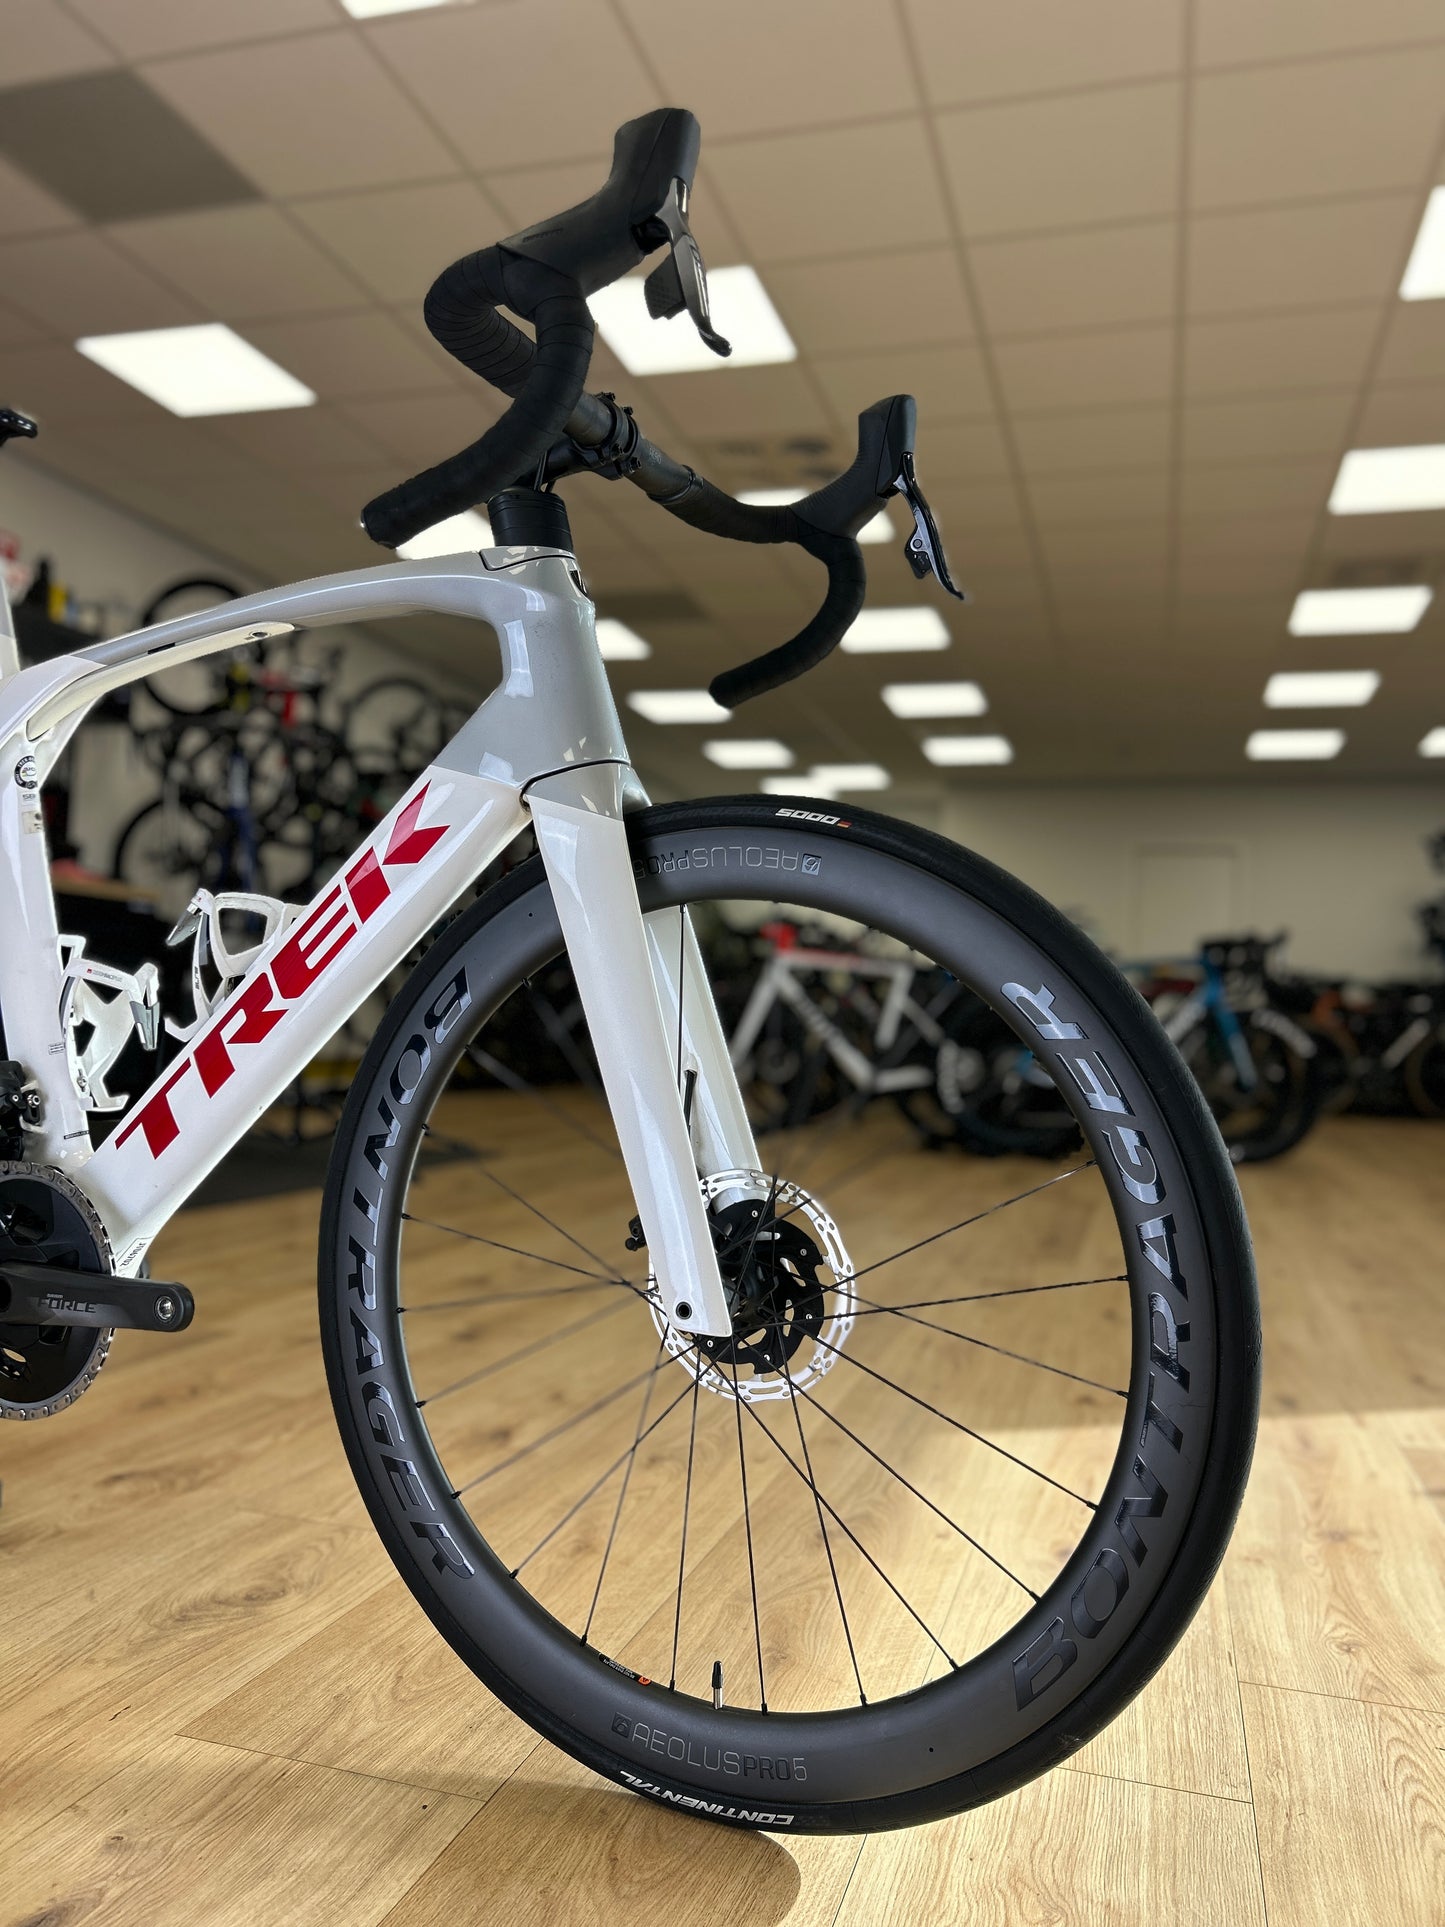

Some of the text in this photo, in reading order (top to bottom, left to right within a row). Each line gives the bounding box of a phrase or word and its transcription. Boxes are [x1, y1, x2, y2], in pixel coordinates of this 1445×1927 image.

[775, 808, 840, 825] 5000
[115, 780, 451, 1160] TREK
[38, 1298, 97, 1313] FORCE
[347, 964, 476, 1579] BONTRAGER
[1001, 982, 1192, 1712] BONTRAGER
[620, 1770, 795, 1825] CONTINENTAL
